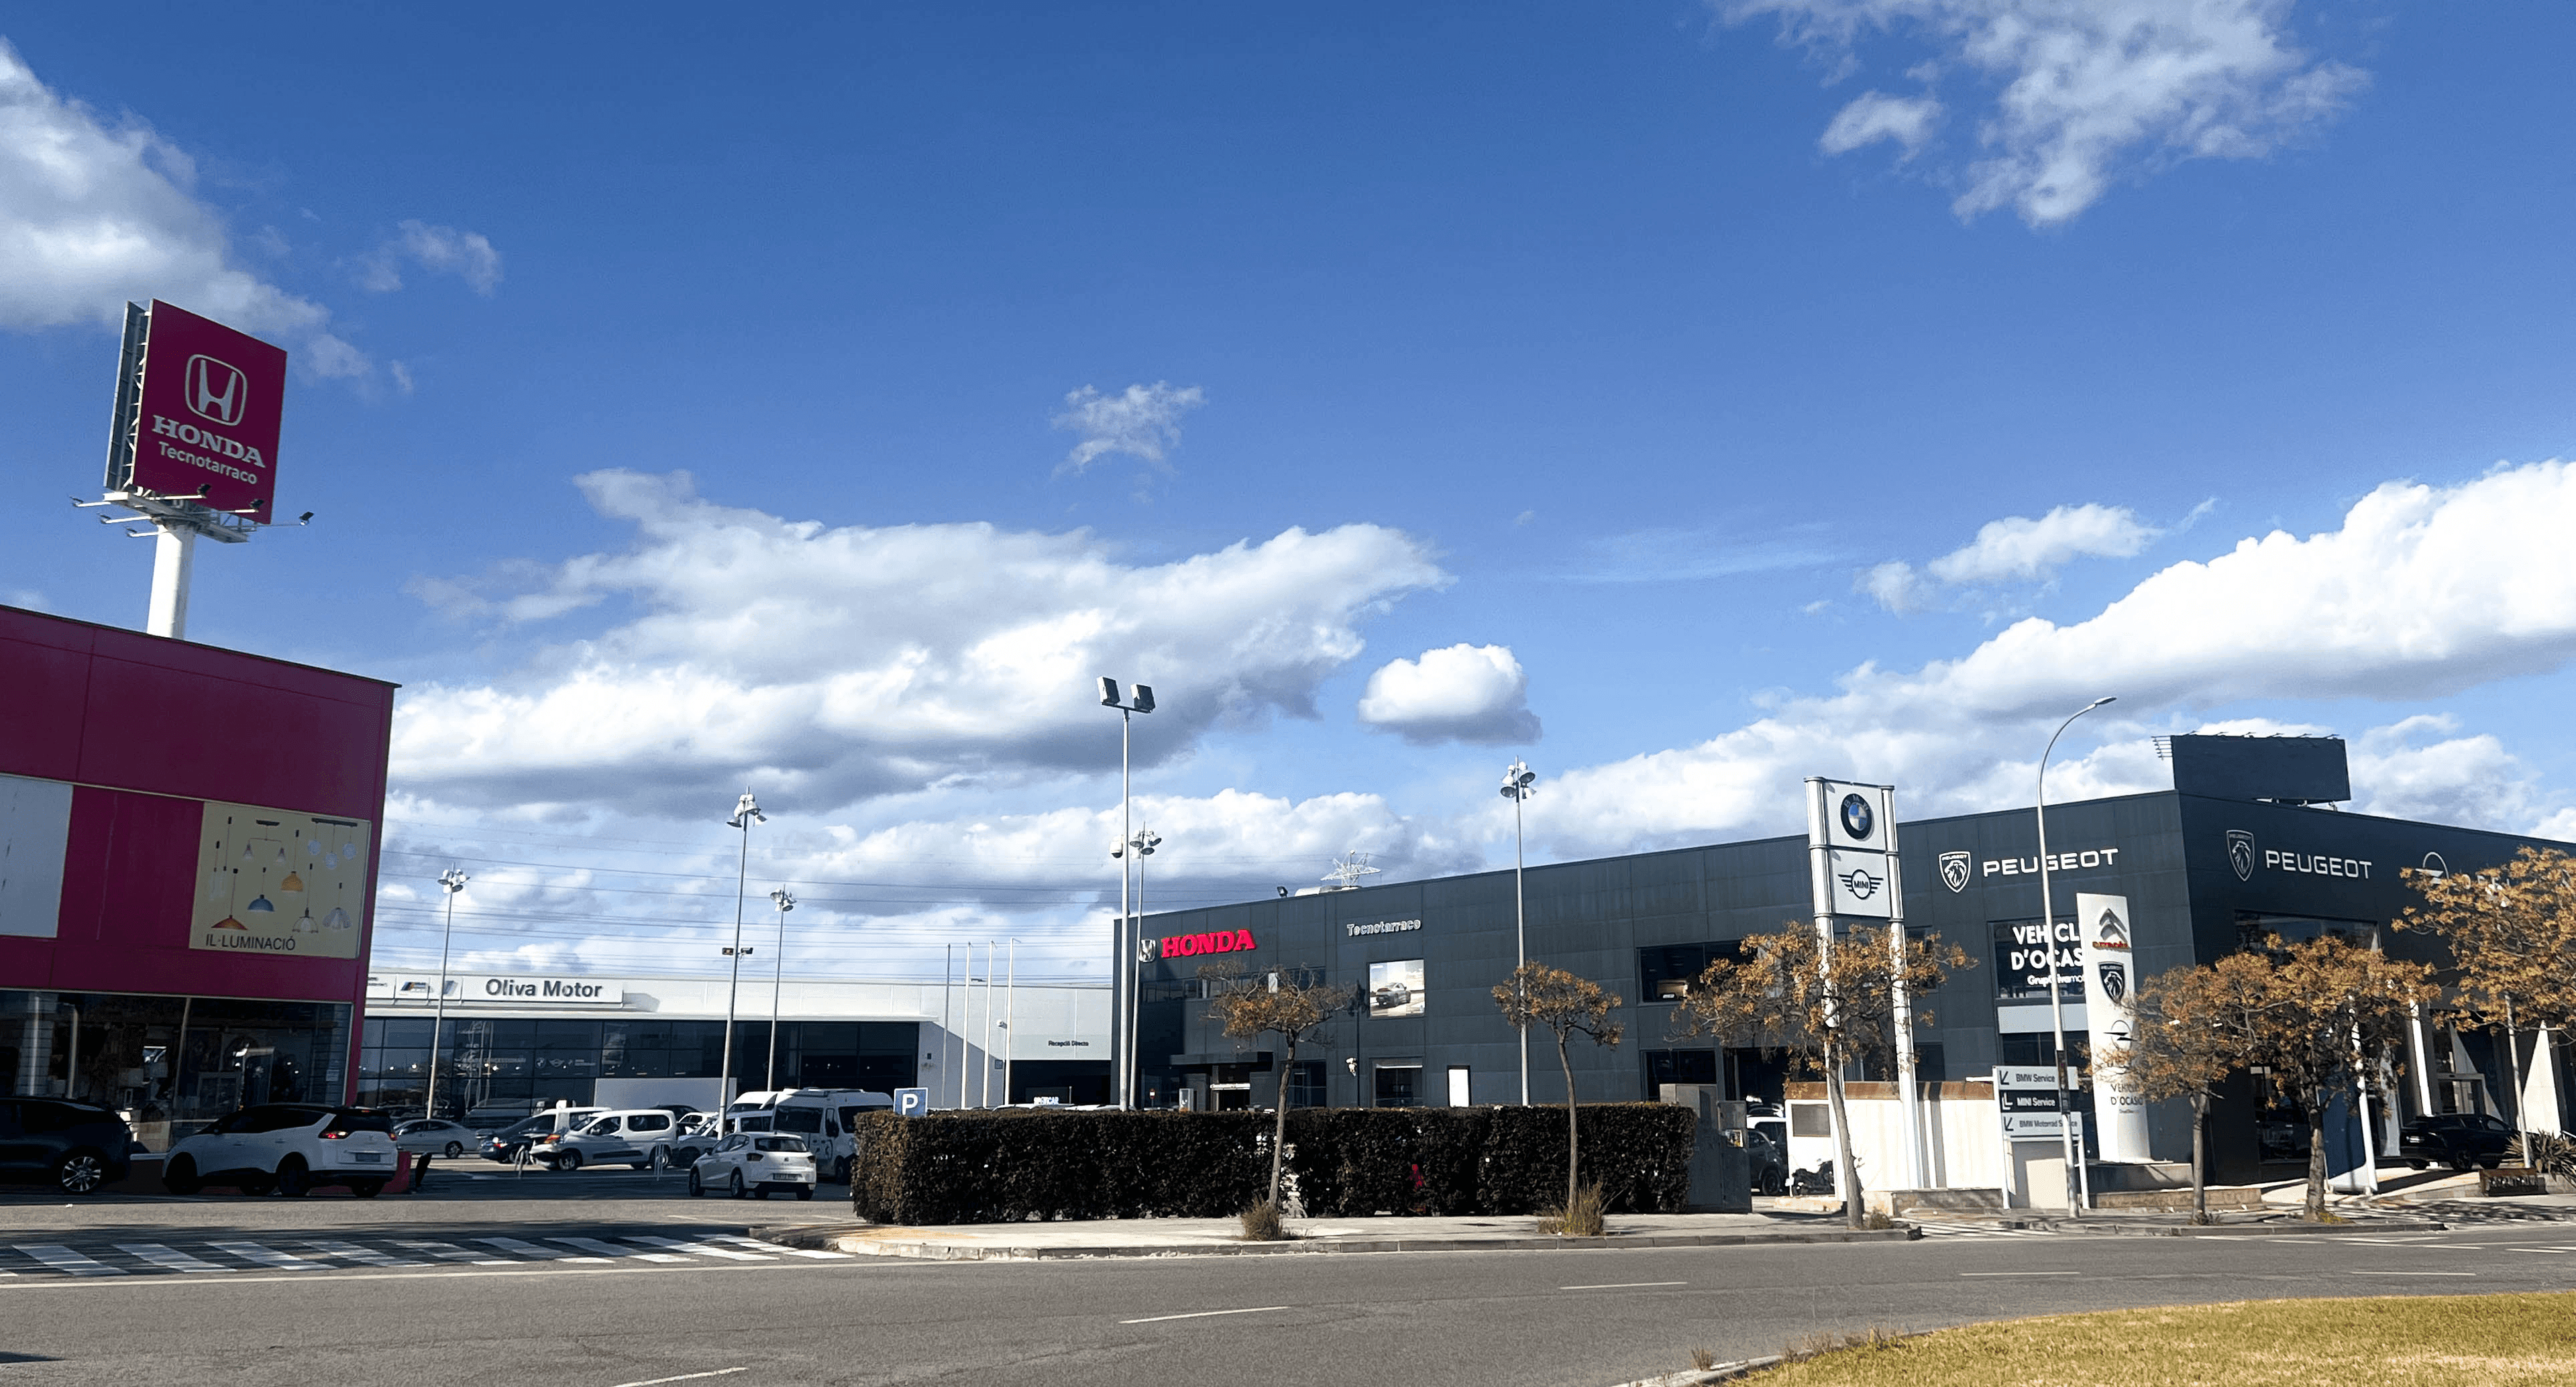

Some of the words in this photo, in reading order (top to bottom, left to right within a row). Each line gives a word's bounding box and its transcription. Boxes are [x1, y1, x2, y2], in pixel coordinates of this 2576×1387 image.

[152, 414, 266, 468] HONDA
[158, 441, 258, 484] Tecnotarraco
[1983, 848, 2118, 877] PEUGEOT
[2265, 850, 2372, 879] PEUGEOT
[1854, 880, 1869, 889] MINI
[1346, 919, 1421, 937] Tecnotarraco
[1161, 929, 1258, 958] HONDA
[486, 979, 536, 996] Oliva
[543, 980, 602, 997] Motor
[2016, 1074, 2033, 1083] BMW
[2033, 1074, 2055, 1083] Service
[902, 1093, 918, 1115] P
[2032, 1097, 2055, 1107] Service
